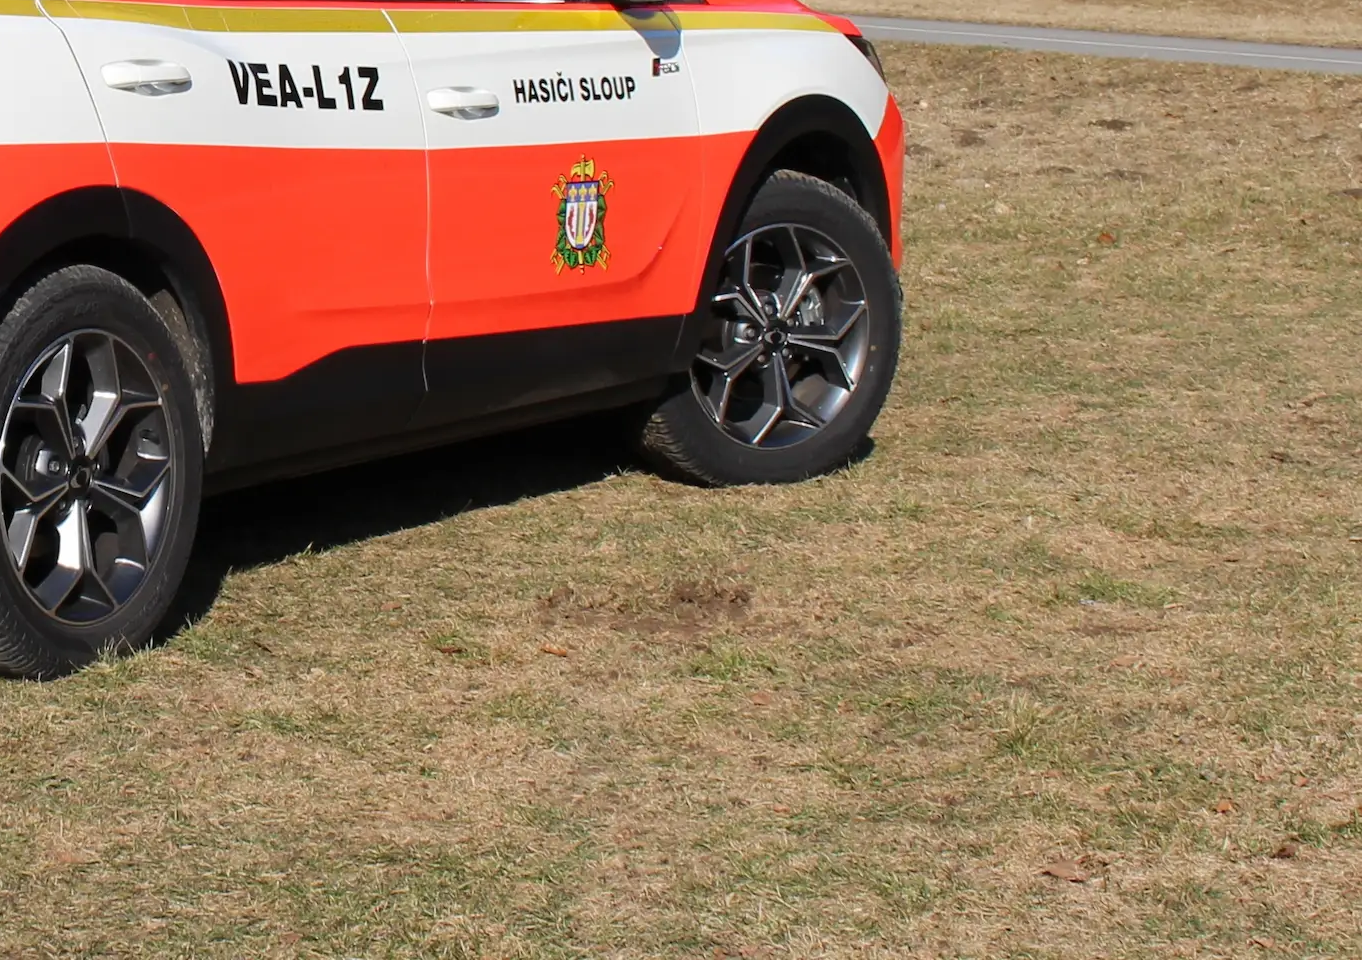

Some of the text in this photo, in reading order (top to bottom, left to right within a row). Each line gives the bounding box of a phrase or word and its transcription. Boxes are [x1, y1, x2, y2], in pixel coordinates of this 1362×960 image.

[226, 58, 385, 111] VEA-L1Z
[512, 71, 636, 103] HASIČI SLOUP
